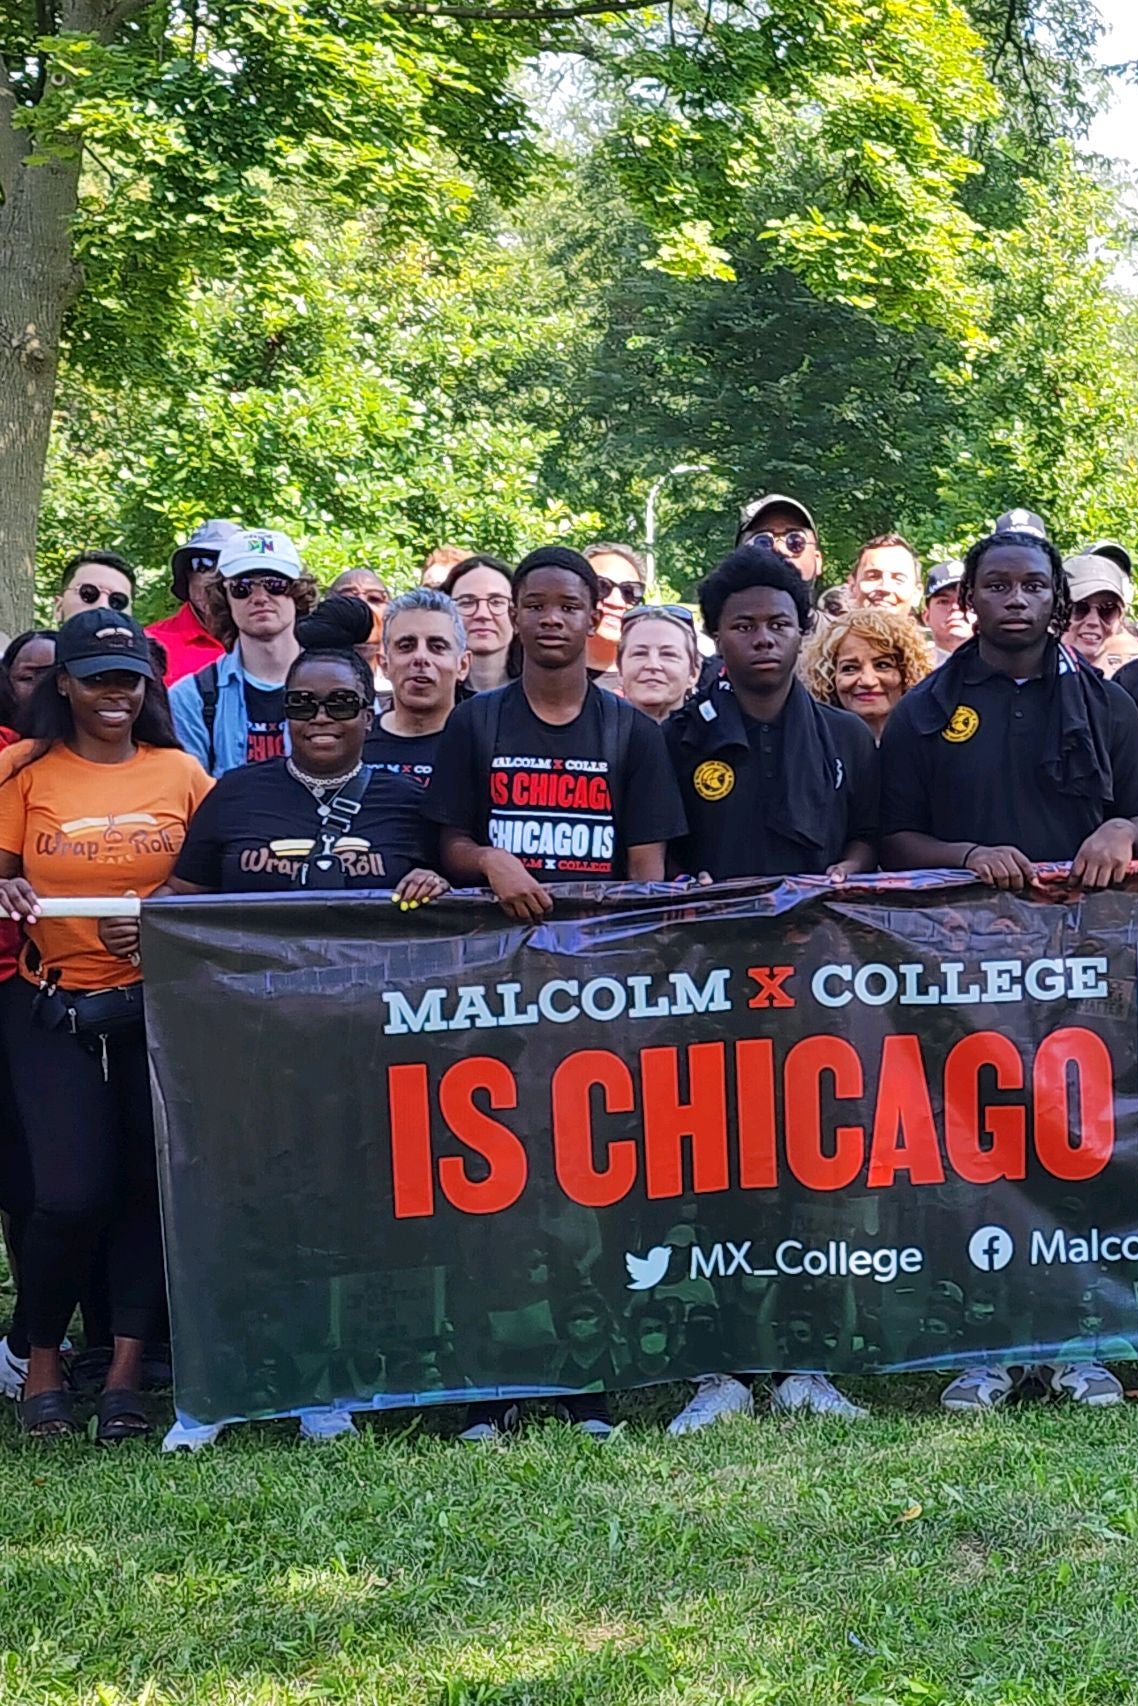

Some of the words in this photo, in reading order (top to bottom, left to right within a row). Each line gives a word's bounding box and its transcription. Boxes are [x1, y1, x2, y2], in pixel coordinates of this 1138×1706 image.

[553, 759, 563, 770] X
[565, 760, 608, 772] COLLE
[490, 772, 508, 805] IS
[512, 772, 612, 812] CHICAG
[36, 831, 99, 861] Wrap
[129, 829, 175, 855] Roll
[489, 819, 590, 857] CHICAGO
[592, 825, 614, 858] IS
[341, 851, 386, 877] Roll
[545, 859, 556, 870] X
[383, 968, 731, 1034] MALCOLM
[748, 966, 795, 1008] X
[811, 957, 1108, 1008] COLLEGE
[388, 1056, 528, 1219] IS
[551, 1026, 1115, 1208] CHICAGO
[690, 1239, 923, 1283] MX_College
